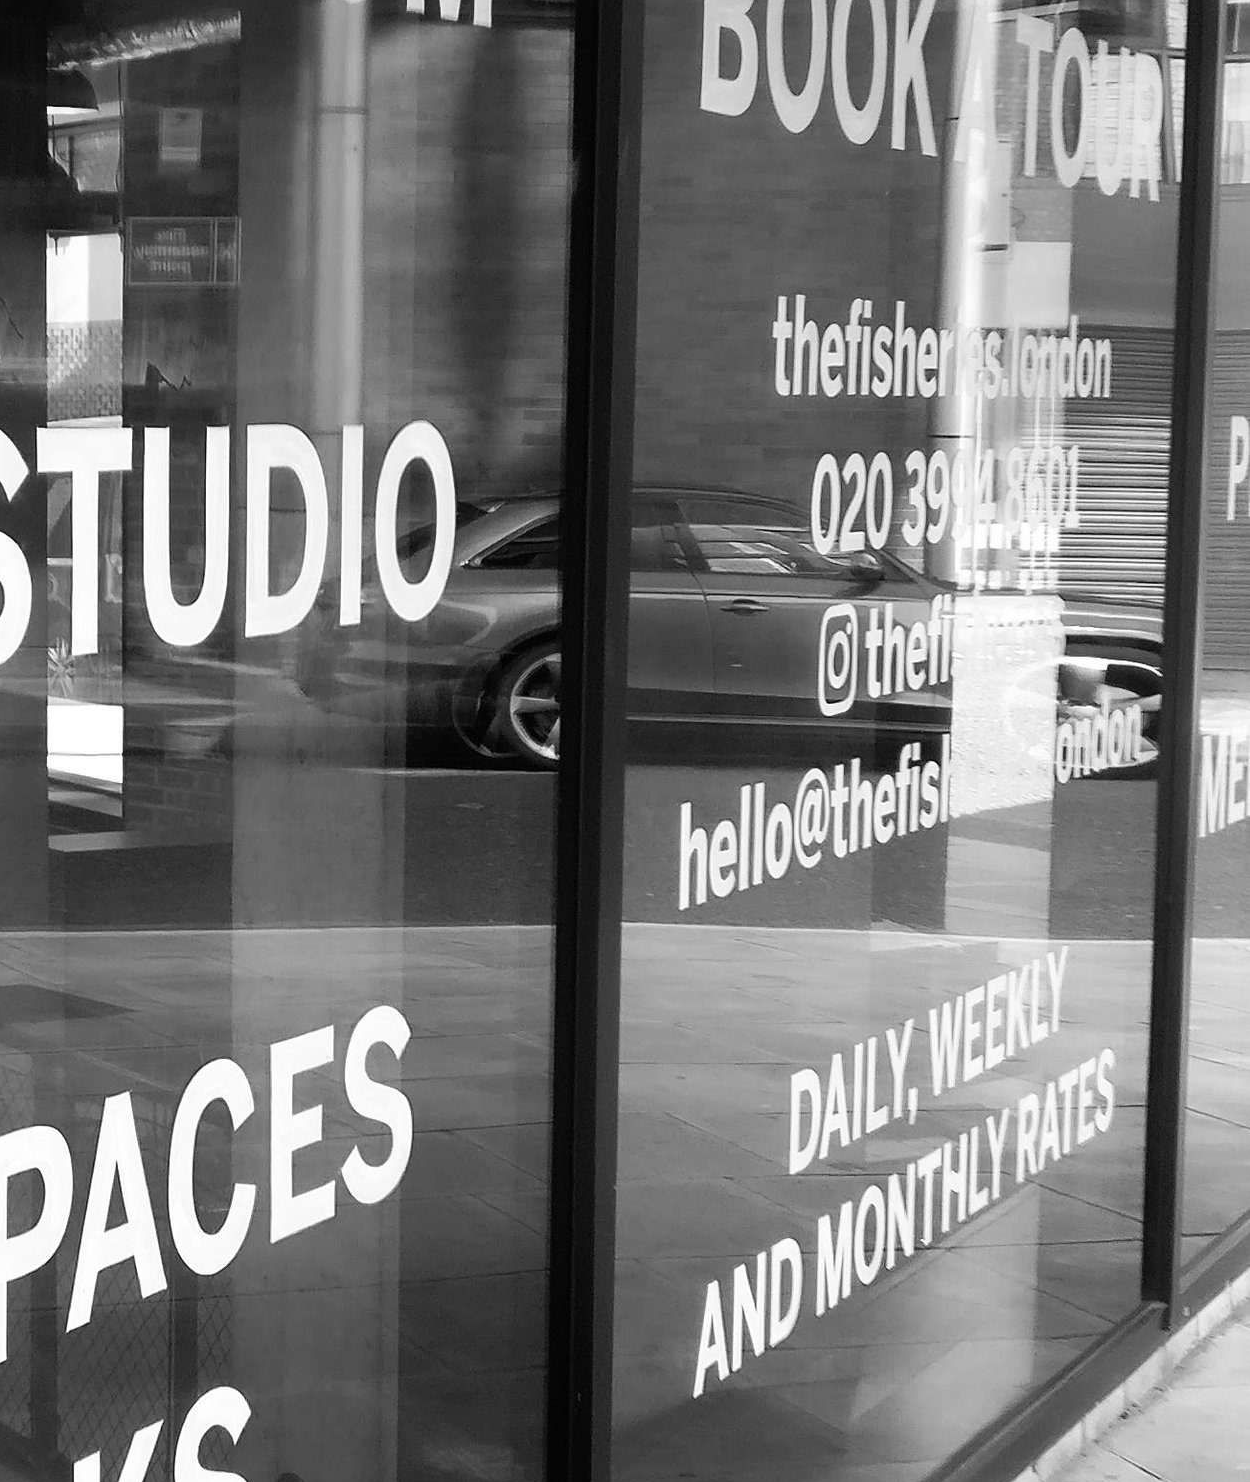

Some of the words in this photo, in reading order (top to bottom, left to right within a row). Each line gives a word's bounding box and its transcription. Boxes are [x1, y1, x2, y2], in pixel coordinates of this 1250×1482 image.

[1014, 13, 1163, 203] TOUR
[772, 294, 1113, 399] thefisheries.london
[810, 451, 893, 555] 020
[901, 449, 997, 546] 3994
[1003, 444, 1080, 535] 8601
[1198, 730, 1250, 838] ME
[789, 1018, 918, 1175] DAILY,
[928, 945, 1069, 1096] WEEKLY
[692, 1237, 803, 1399] AND
[815, 1107, 1011, 1317] MONTHLY
[1016, 1047, 1116, 1183] RATES
